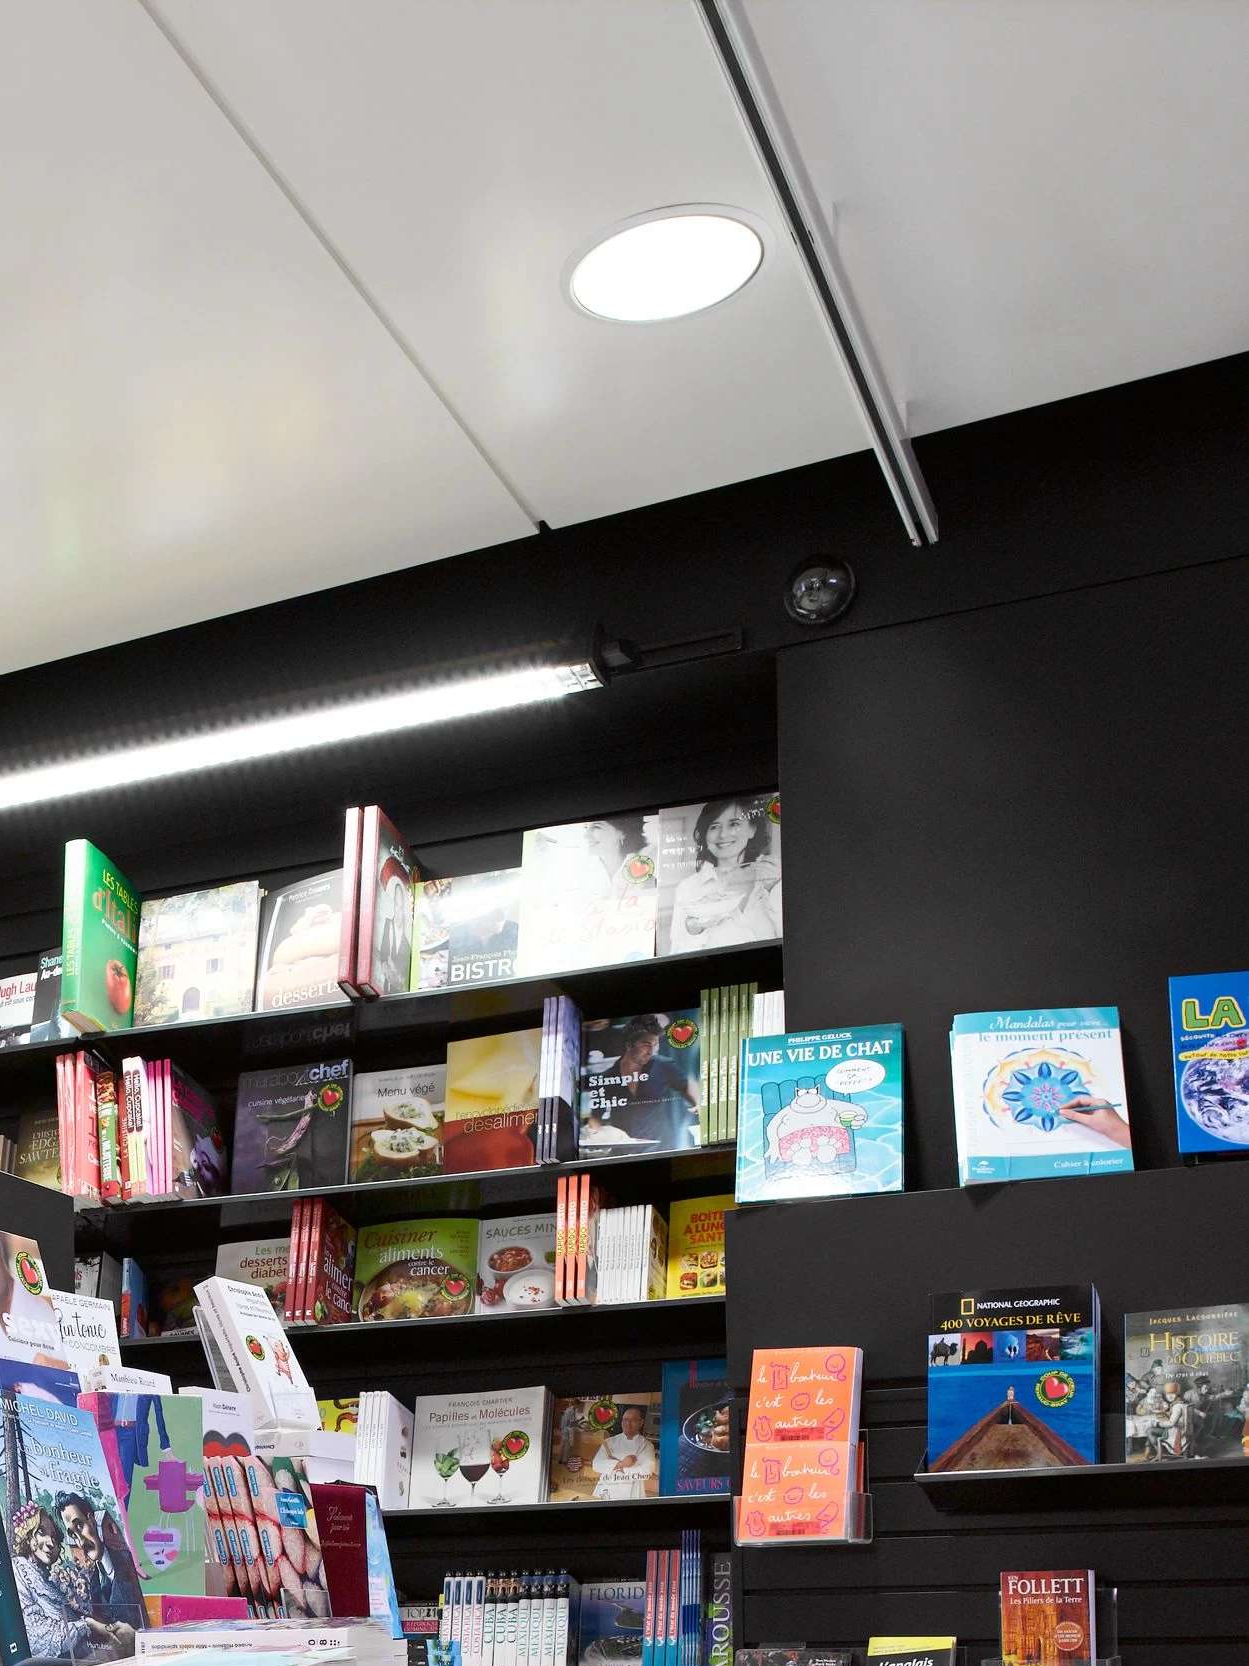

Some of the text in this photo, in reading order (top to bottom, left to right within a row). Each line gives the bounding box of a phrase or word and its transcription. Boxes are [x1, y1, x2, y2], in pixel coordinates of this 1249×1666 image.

[271, 976, 340, 1008] desserts
[990, 1016, 1054, 1030] Mandalas
[1182, 996, 1246, 1031] LA
[788, 1034, 820, 1044] PHILIPPE
[979, 1029, 1112, 1042] le moment présent
[748, 1040, 893, 1067] UNE VIE DE CHAT
[309, 1059, 348, 1081] chef
[589, 1072, 649, 1087] Simple
[377, 1084, 435, 1098] Menu végé
[589, 1088, 605, 1098] et
[589, 1097, 627, 1109] Chic
[1054, 1158, 1124, 1169] Cahier colorier
[364, 1227, 437, 1249] Cuisiner
[486, 1226, 530, 1239] SAUCES
[240, 1256, 288, 1268] desserts
[379, 1246, 443, 1263] aliments
[411, 1265, 450, 1276] cancer
[976, 1298, 1061, 1310] NATIONAL GEOGRAPHIC
[940, 1311, 1081, 1331] 400 VOYAGES DE RÊVE
[70, 1340, 116, 1355] CONCOMBRE
[1150, 1331, 1238, 1351] HISTOIRE
[757, 1362, 837, 1384] le bonheur
[756, 1389, 834, 1408] c'est les
[0, 1397, 78, 1426] MICHEL DAVID
[429, 1406, 530, 1424] Papilles Molécules
[774, 1416, 818, 1429] autres
[29, 1437, 92, 1466] bonheur
[48, 1461, 100, 1490] fragile
[750, 1456, 832, 1478] le bonheur
[676, 1477, 722, 1491] SAVEURS
[748, 1483, 827, 1503] c'est les
[768, 1509, 811, 1523] autres
[1008, 1578, 1084, 1595] FOLLETT
[484, 1608, 495, 1644] CUBA
[496, 1608, 507, 1644] CUBA
[508, 1607, 517, 1643] CUBA
[518, 1606, 528, 1656] MEXIQUE
[530, 1606, 540, 1656] MEXIQUE
[545, 1606, 555, 1656] MEXIQUE
[557, 1606, 567, 1656] MEXIQUE
